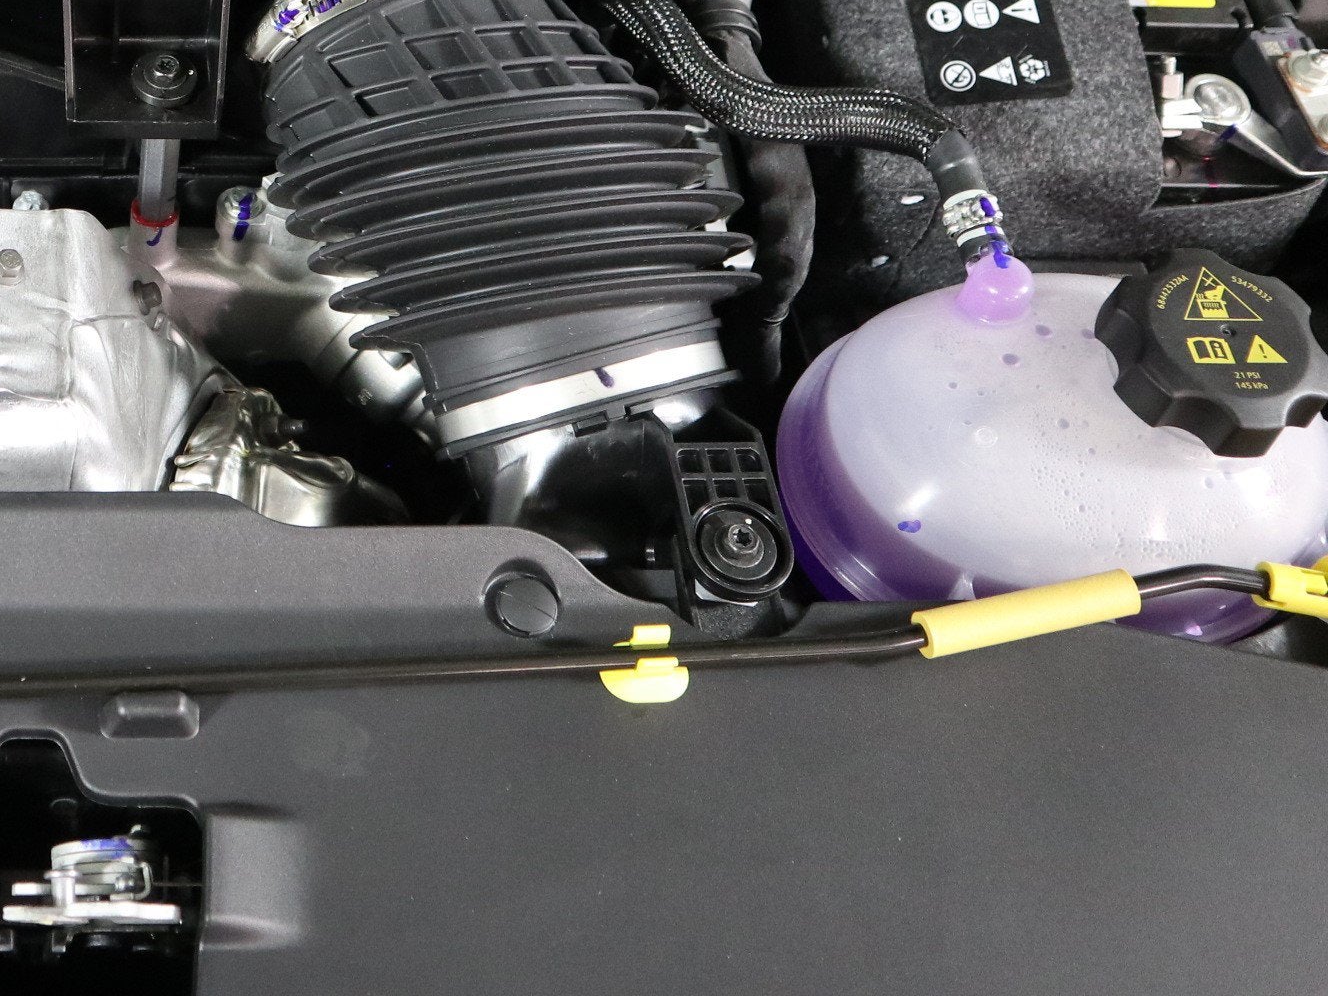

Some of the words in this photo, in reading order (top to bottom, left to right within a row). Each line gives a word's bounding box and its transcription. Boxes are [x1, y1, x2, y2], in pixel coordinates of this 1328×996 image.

[1230, 275, 1274, 304] 53479332
[1234, 371, 1245, 379] 21
[1246, 371, 1261, 379] PSI
[1235, 381, 1252, 390] 145
[1253, 381, 1269, 390] kPa
